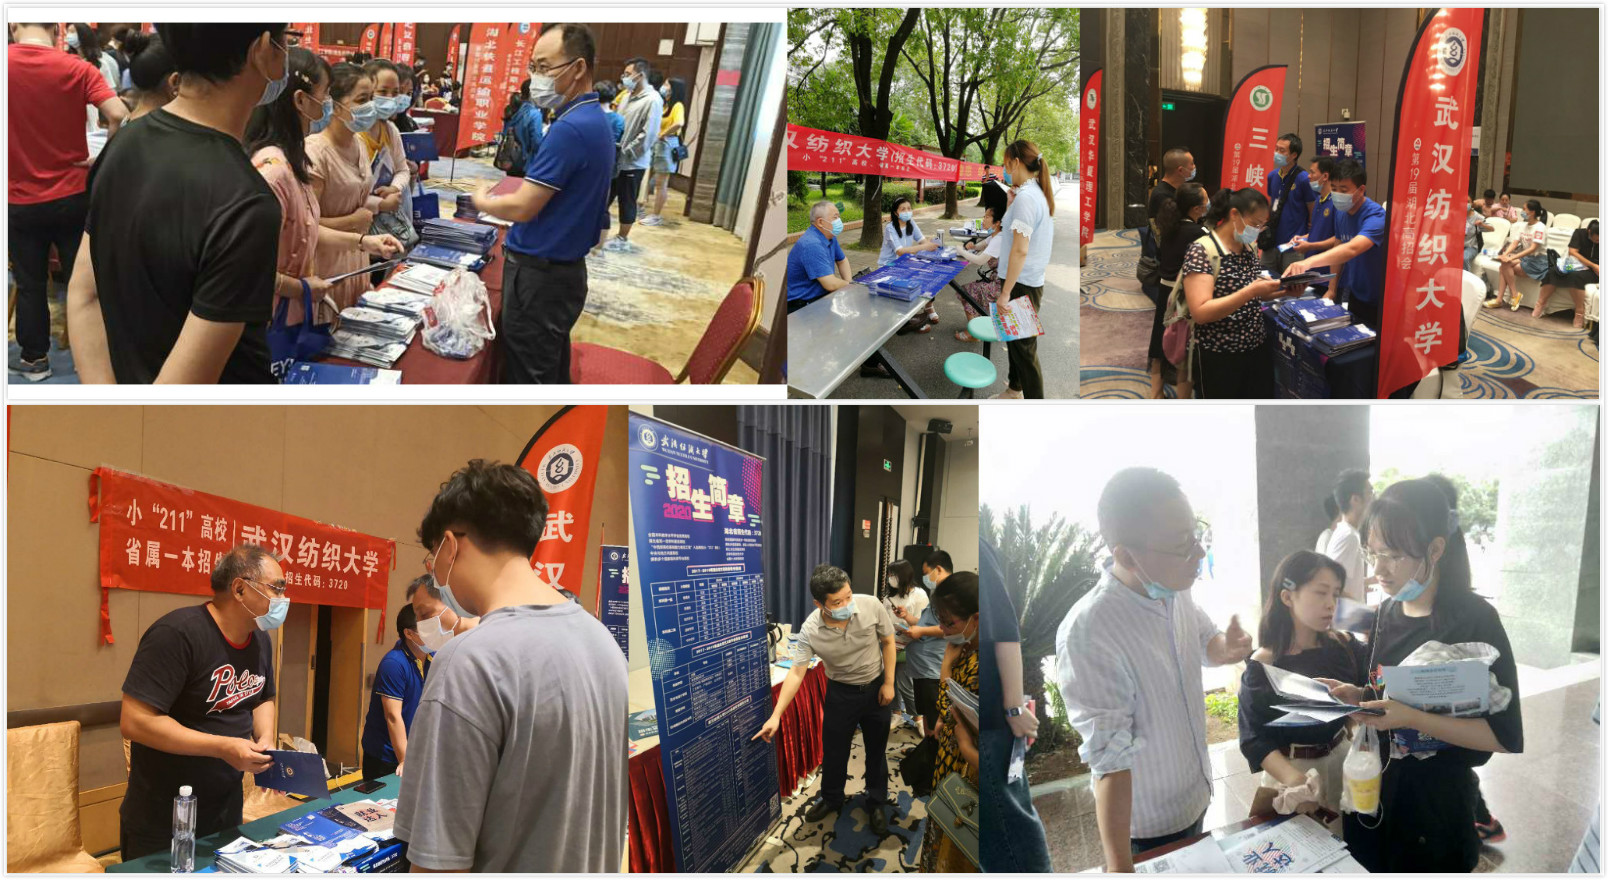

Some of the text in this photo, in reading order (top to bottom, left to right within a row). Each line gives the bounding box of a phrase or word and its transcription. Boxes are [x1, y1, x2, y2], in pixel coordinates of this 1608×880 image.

[1245, 127, 1269, 188] 三峡
[1401, 152, 1421, 270] 第19届湖北高招会
[1414, 95, 1459, 355] 武汉纺织大学
[663, 503, 692, 520] 2020
[665, 464, 746, 524] 招生简章
[241, 525, 379, 578] 武汉纺织大学
[534, 510, 574, 590] 武汉
